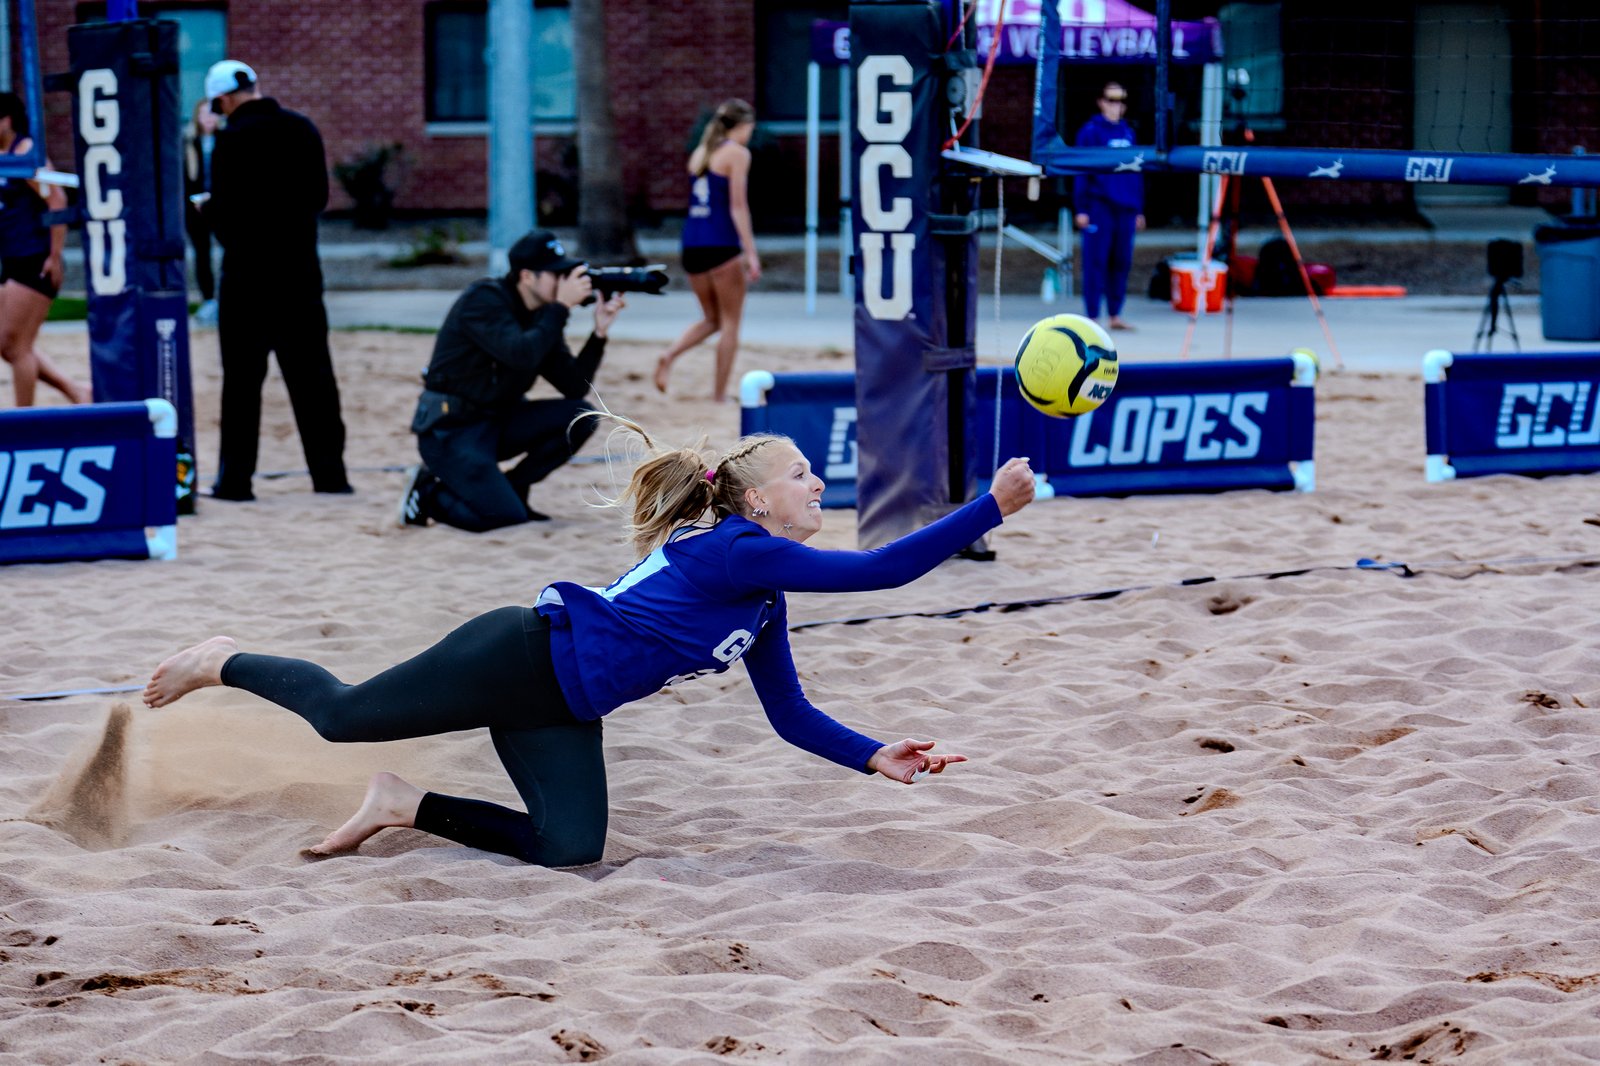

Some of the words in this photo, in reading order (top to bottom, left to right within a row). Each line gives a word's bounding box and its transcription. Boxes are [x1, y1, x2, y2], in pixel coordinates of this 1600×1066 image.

[78, 67, 127, 296] GCU
[857, 54, 916, 321] GCU
[1203, 151, 1248, 175] GCU
[1405, 157, 1453, 182] GCU
[1069, 391, 1269, 468] LOPES
[1496, 381, 1600, 449] GCU
